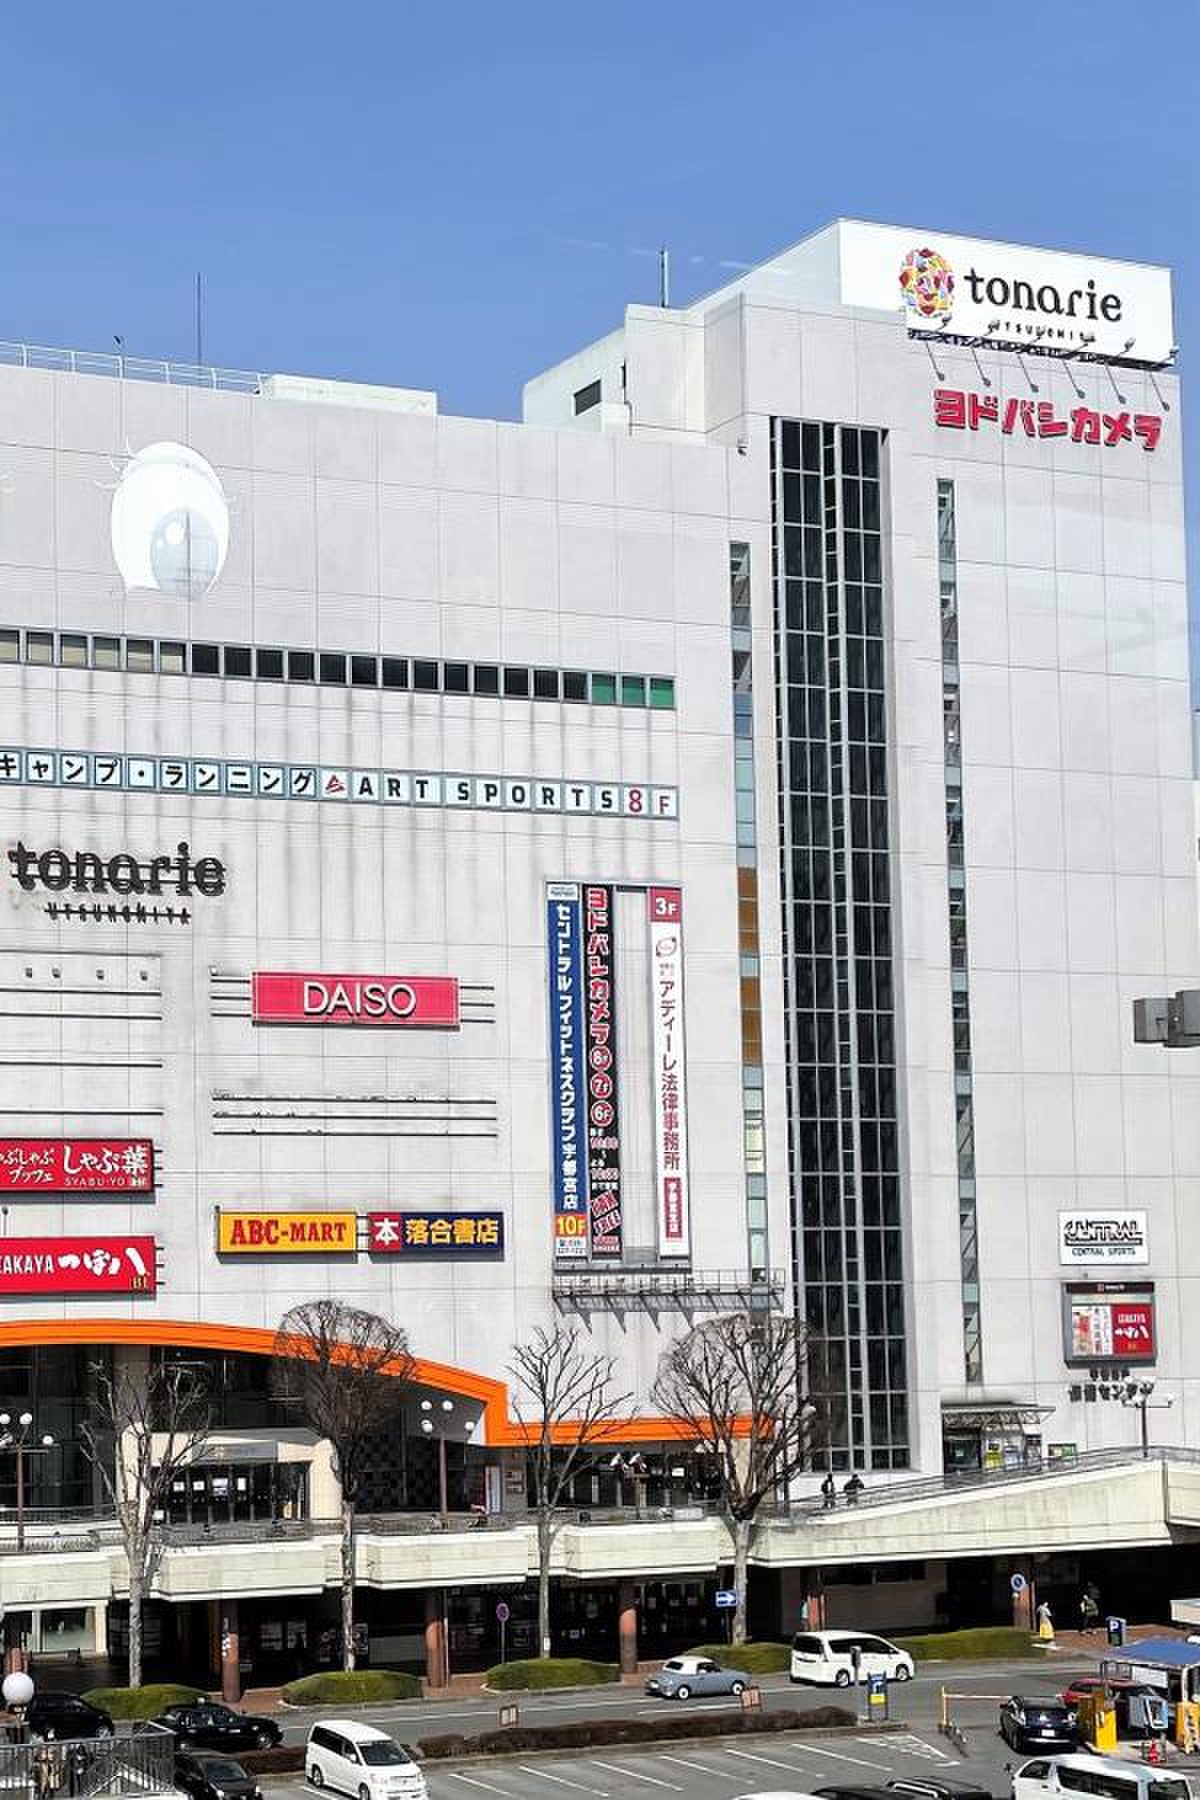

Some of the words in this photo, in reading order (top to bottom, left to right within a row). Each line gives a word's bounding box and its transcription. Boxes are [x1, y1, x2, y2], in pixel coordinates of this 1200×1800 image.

[964, 267, 1122, 322] tonarie
[934, 389, 1162, 450] ヨドバシカメラ
[358, 779, 429, 799] ART
[457, 781, 613, 809] SPORTS
[8, 841, 226, 896] tonarie
[656, 898, 679, 915] 3F
[587, 887, 610, 1044] ヨドバシカメラ
[303, 981, 417, 1019] DAISO
[64, 1145, 149, 1176] しゃぶ葉
[230, 1218, 347, 1245] ABC-MART
[374, 1218, 400, 1244] 本
[406, 1218, 499, 1245] 落合書店
[557, 1215, 587, 1235] 10F
[57, 1247, 151, 1277] つぼ八
[1109, 1620, 1120, 1632] P
